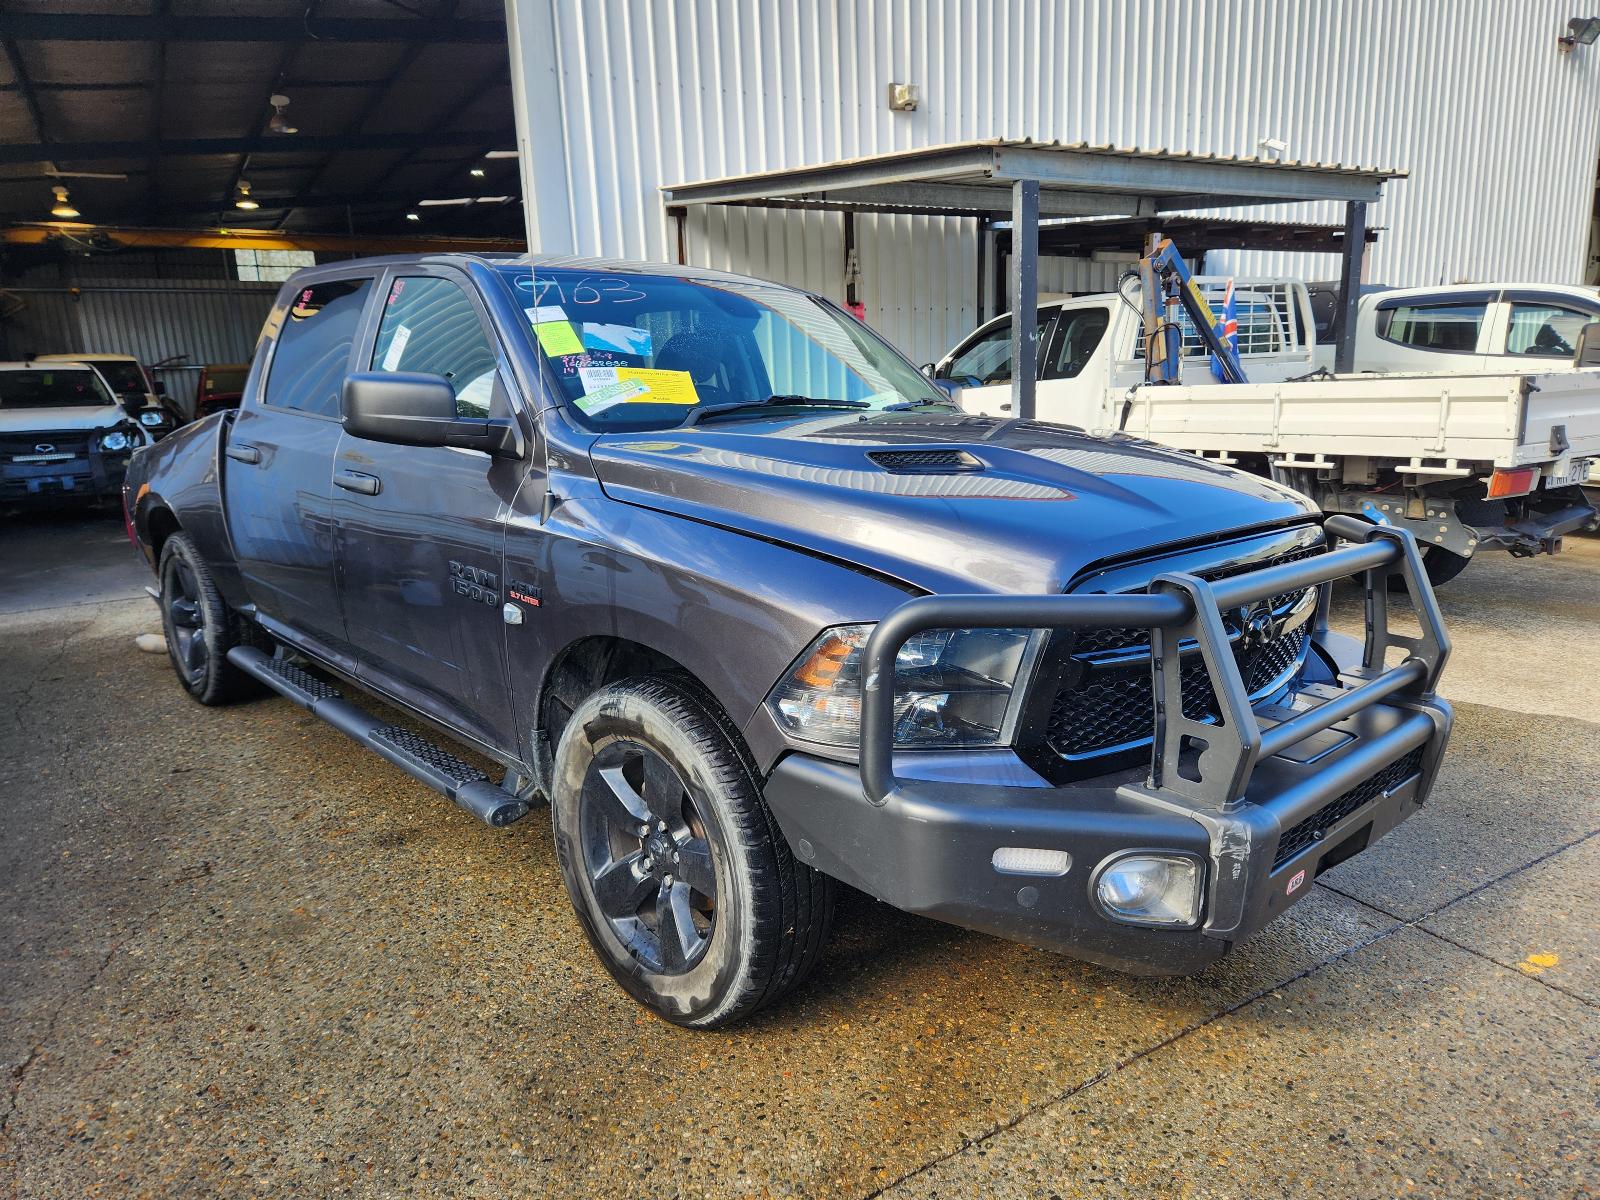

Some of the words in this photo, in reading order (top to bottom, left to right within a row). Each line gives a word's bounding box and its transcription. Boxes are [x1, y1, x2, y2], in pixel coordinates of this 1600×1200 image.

[513, 275, 647, 305] 9163
[448, 560, 498, 589] RAM
[449, 577, 499, 607] 1500
